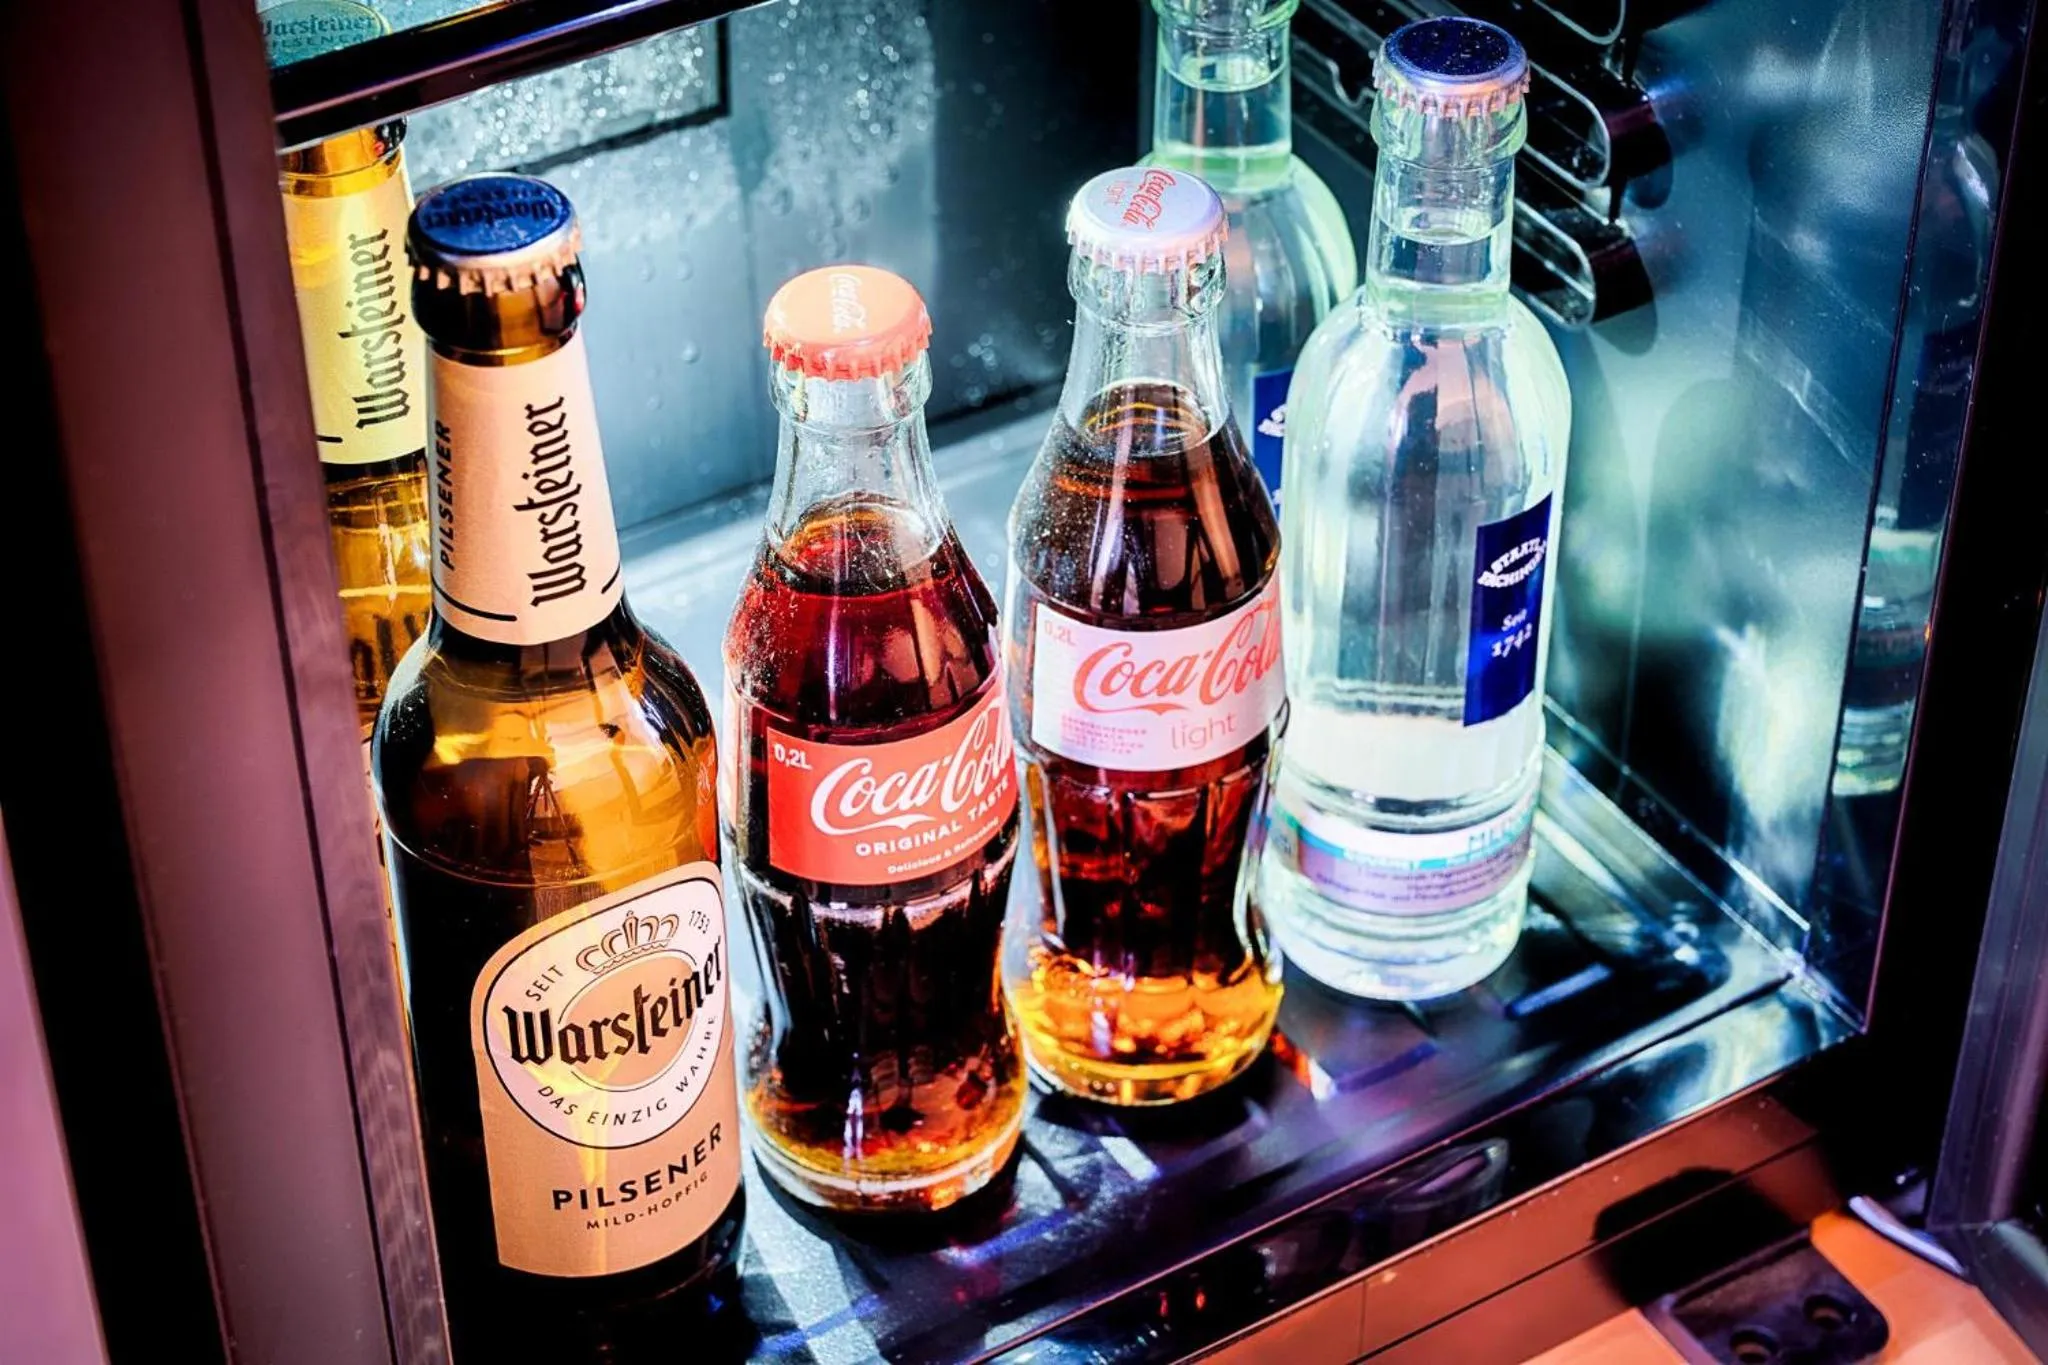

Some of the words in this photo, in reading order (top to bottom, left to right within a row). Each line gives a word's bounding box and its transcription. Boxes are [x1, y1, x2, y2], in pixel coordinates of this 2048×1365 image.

[271, 33, 364, 49] ILSENER
[338, 228, 411, 430] Warsteiner
[434, 419, 456, 572] PILSENER
[513, 396, 587, 608] Warsteiner
[773, 742, 813, 770] 0,2L
[1171, 712, 1238, 751] light
[855, 819, 963, 857] ORIGINAL
[525, 964, 565, 1002] SEIT
[688, 909, 711, 935] 1753
[502, 935, 722, 1067] Warsteiner
[537, 1085, 579, 1116] DAS
[586, 1097, 668, 1127] EINZIG
[552, 1121, 722, 1211] PILSENER
[586, 1170, 709, 1230] MILD-HOPFIG
